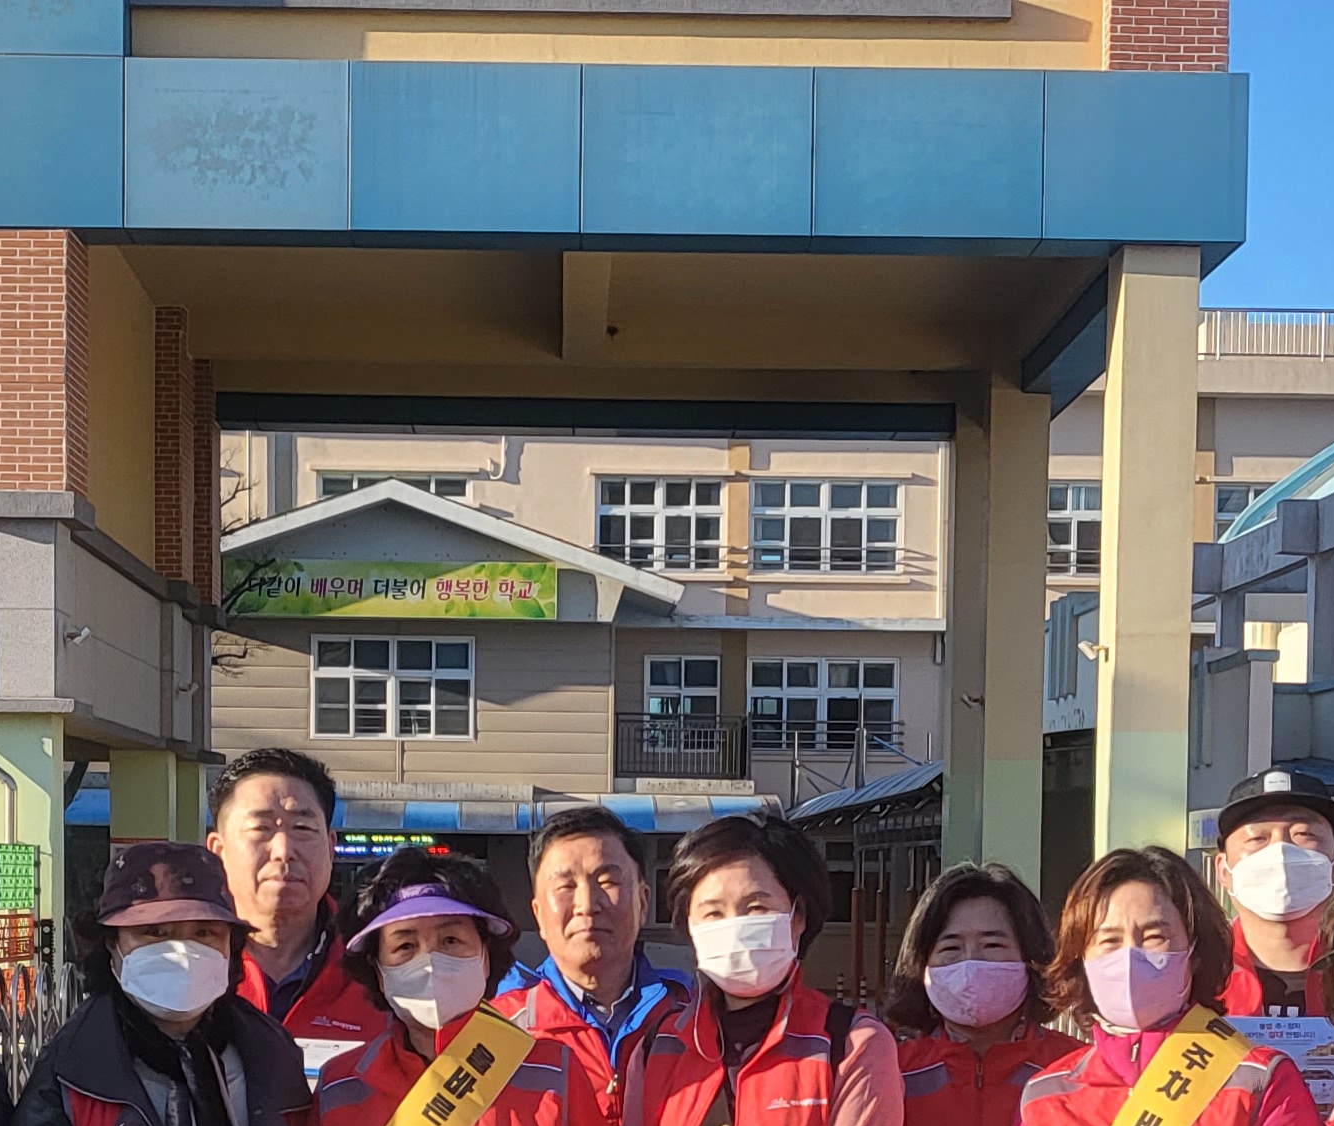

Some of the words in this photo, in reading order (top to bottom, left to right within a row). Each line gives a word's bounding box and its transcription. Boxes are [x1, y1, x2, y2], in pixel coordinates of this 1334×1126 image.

[310, 577, 364, 599] 배우며
[374, 578, 427, 600] 더불어
[436, 578, 489, 601] 행복한
[498, 578, 534, 601] 학교
[421, 1042, 496, 1126] 올바른
[1156, 1041, 1215, 1101] 주차
